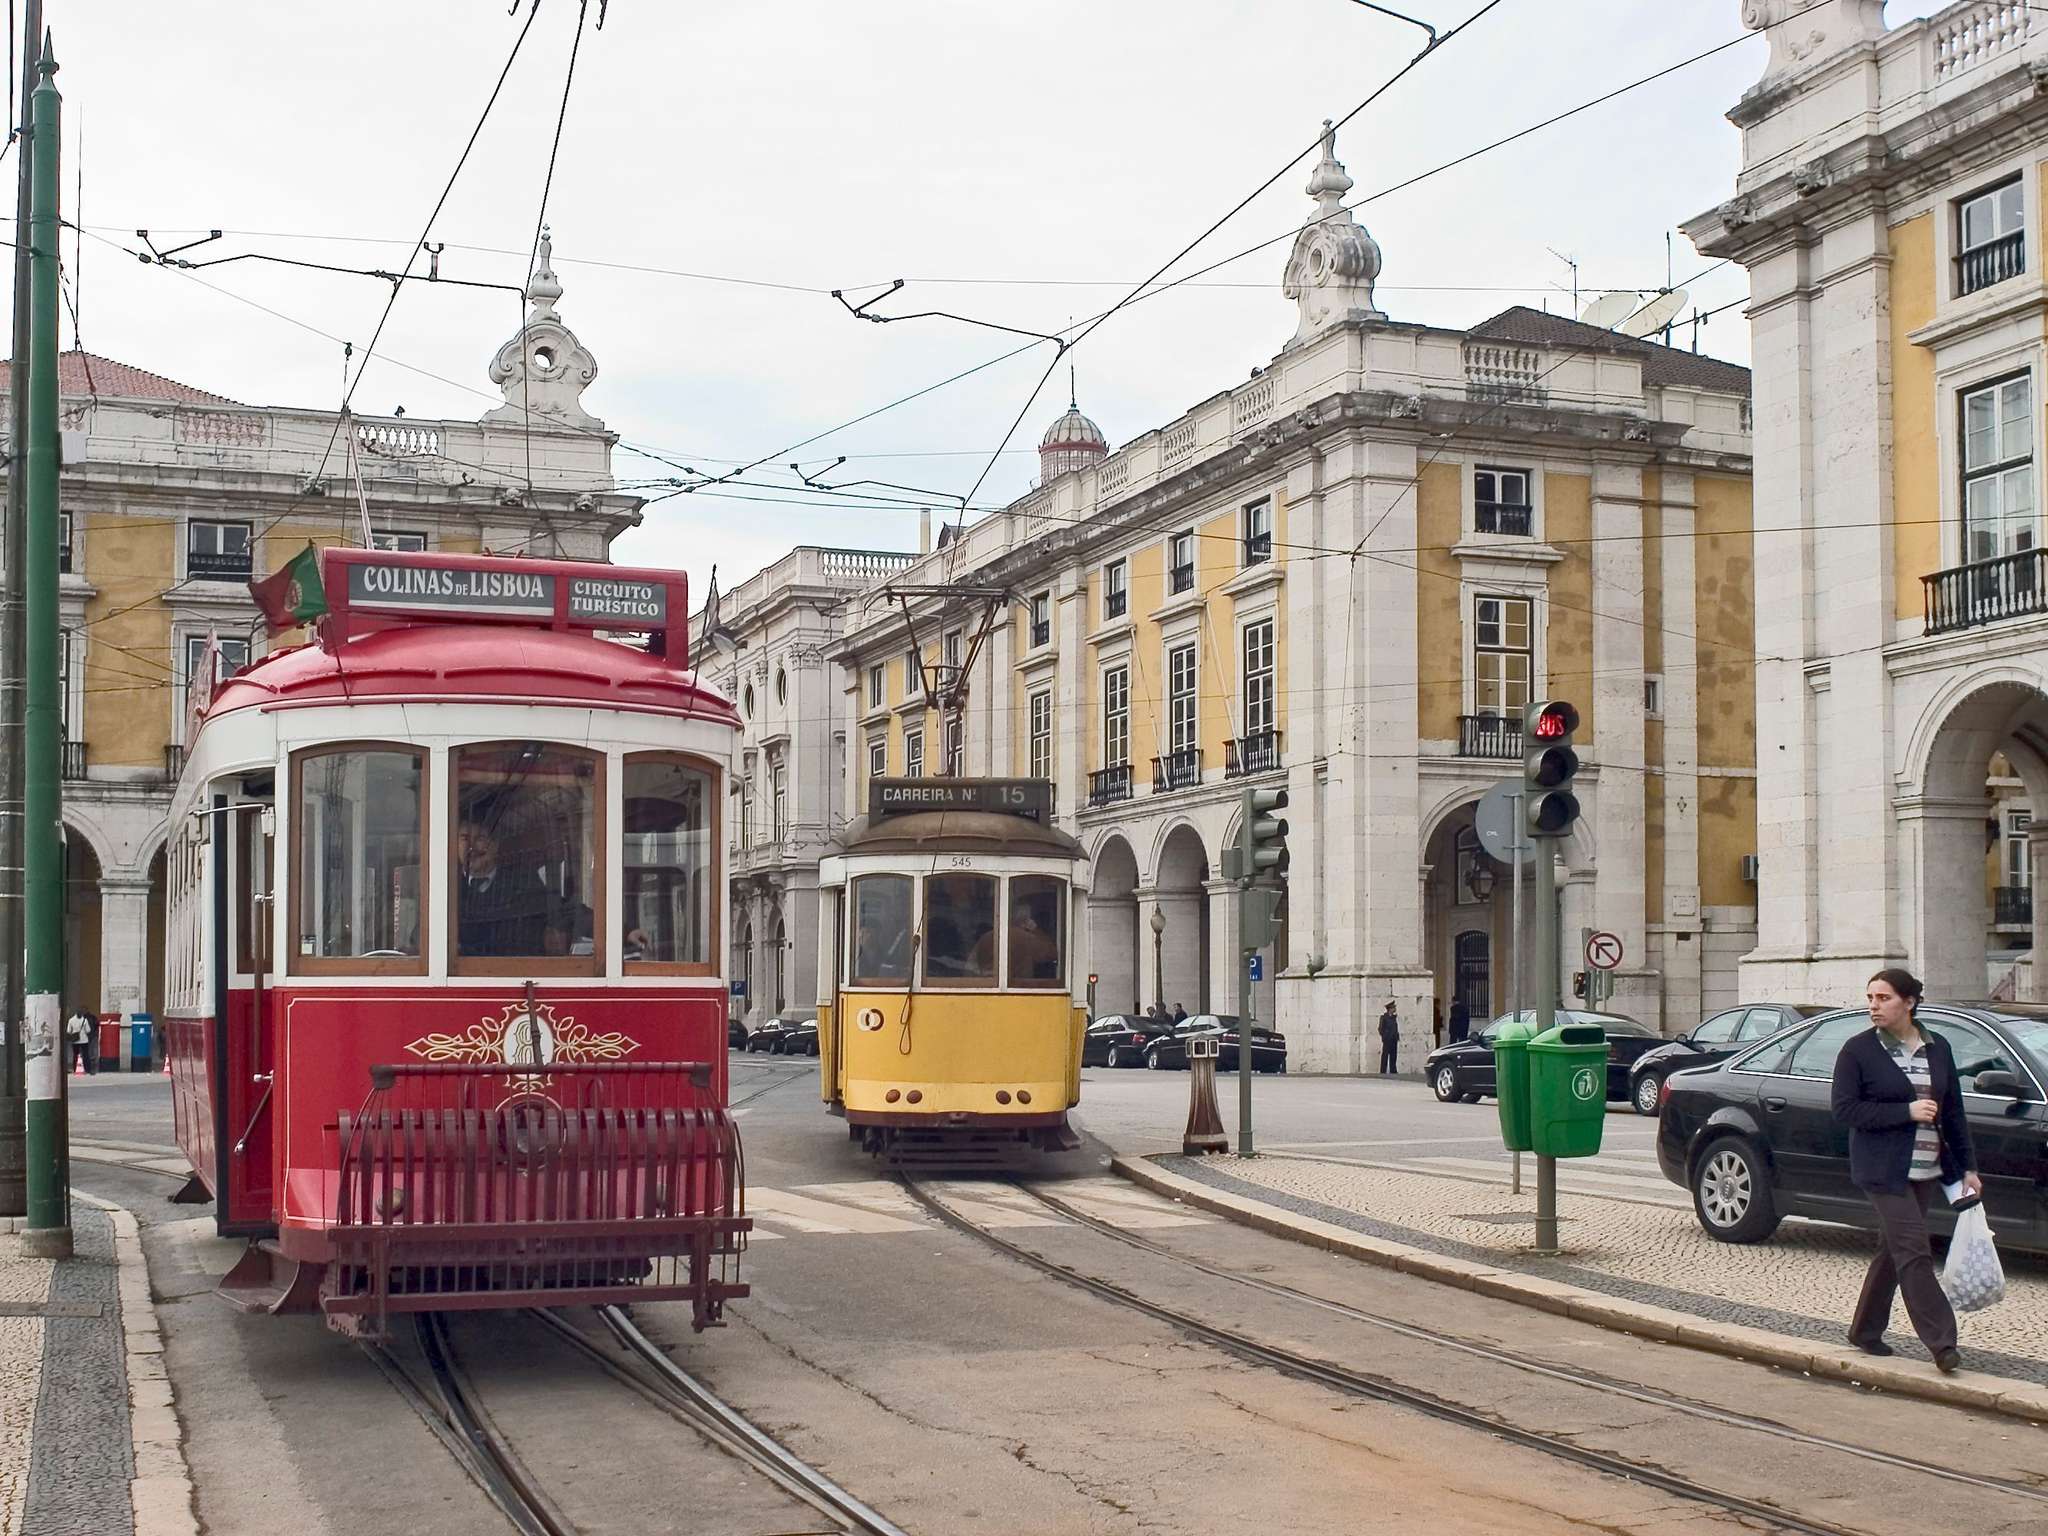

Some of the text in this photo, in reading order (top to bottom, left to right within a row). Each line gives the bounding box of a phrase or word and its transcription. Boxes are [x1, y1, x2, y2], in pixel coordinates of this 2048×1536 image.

[364, 566, 544, 598] COLINAS DE LISBOA
[574, 581, 652, 600] CIRCUITO
[571, 597, 659, 616] TURÍSTICO
[883, 788, 953, 801] CARREIRA
[1000, 786, 1025, 804] 15
[951, 857, 971, 867] 545
